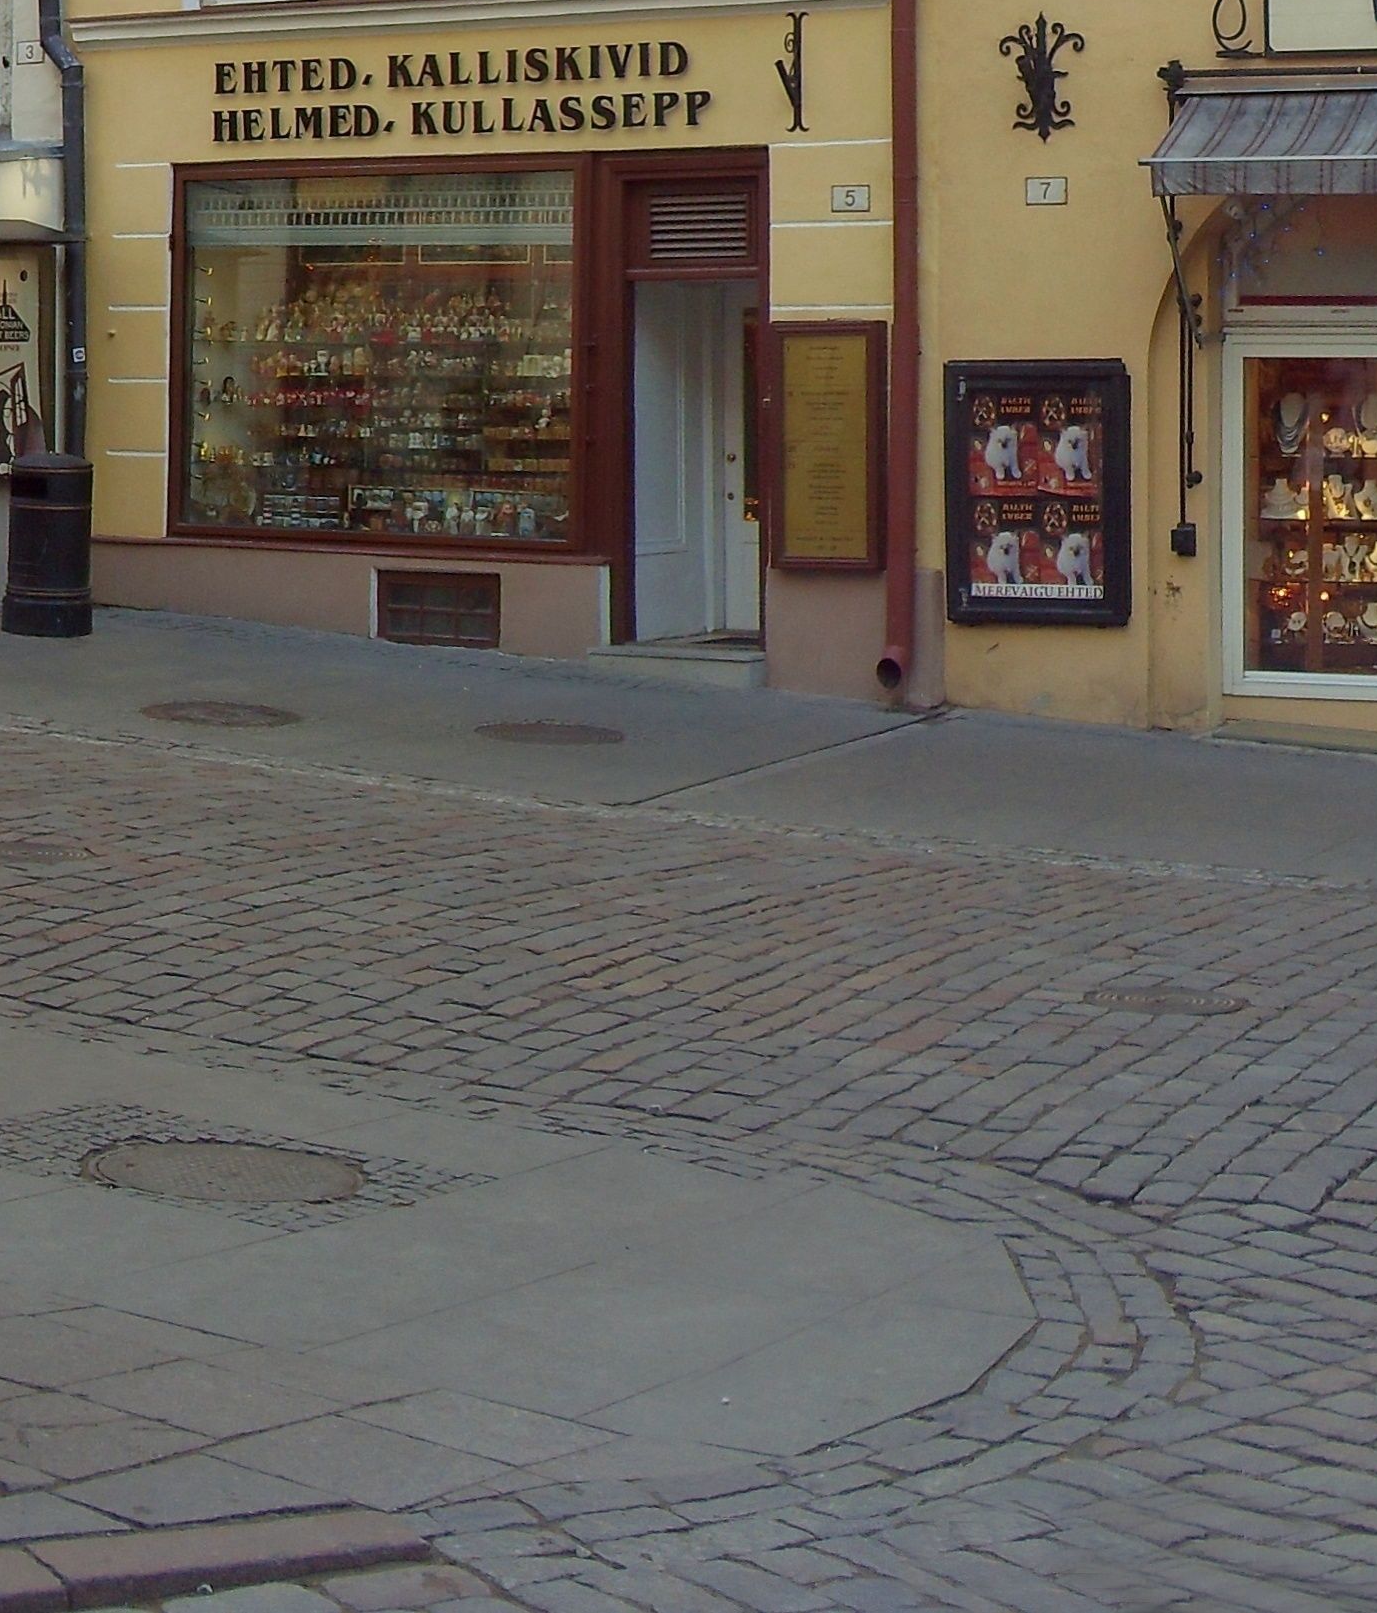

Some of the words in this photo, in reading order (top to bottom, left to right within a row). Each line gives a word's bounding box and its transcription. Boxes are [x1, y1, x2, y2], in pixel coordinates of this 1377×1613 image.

[25, 44, 34, 60] 3
[387, 41, 689, 88] KALLISKIVID
[411, 90, 712, 136] KULLASSEPP
[844, 189, 856, 207] 5
[1039, 181, 1052, 199] 7
[975, 585, 1054, 597] MEREVAIGU
[1057, 586, 1104, 598] EHTED
